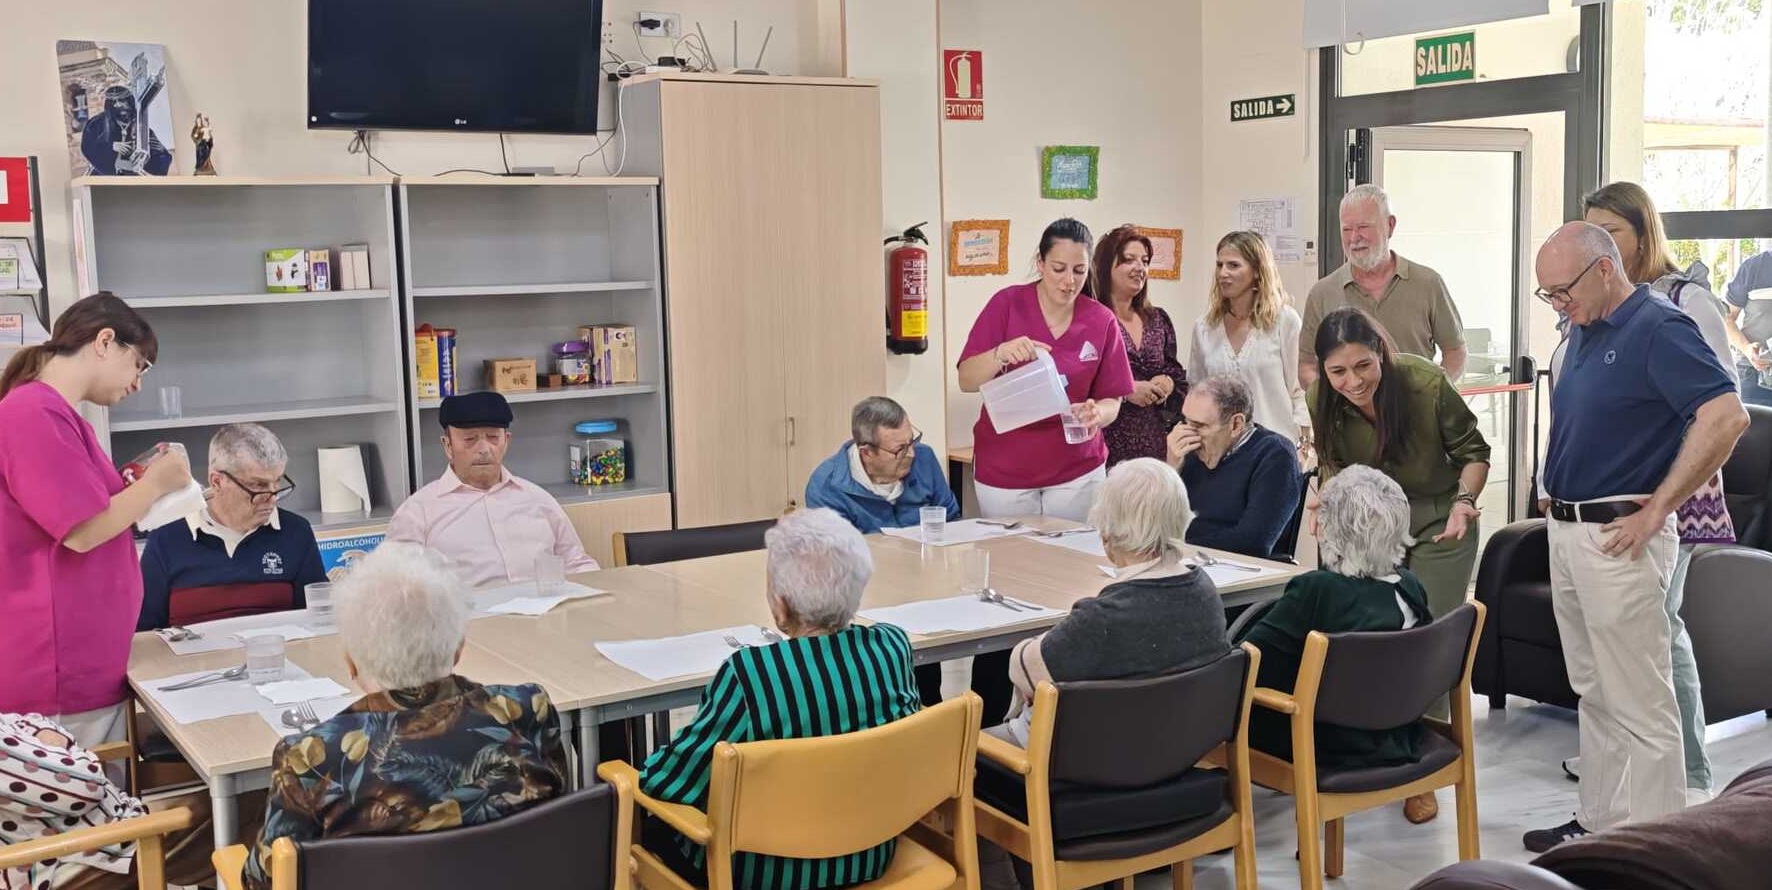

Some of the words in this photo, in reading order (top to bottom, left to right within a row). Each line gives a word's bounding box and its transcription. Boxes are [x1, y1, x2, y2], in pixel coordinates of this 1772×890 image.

[1416, 41, 1473, 77] SALIDA
[945, 104, 983, 117] EXTINTOR
[1233, 100, 1274, 118] SALIDA
